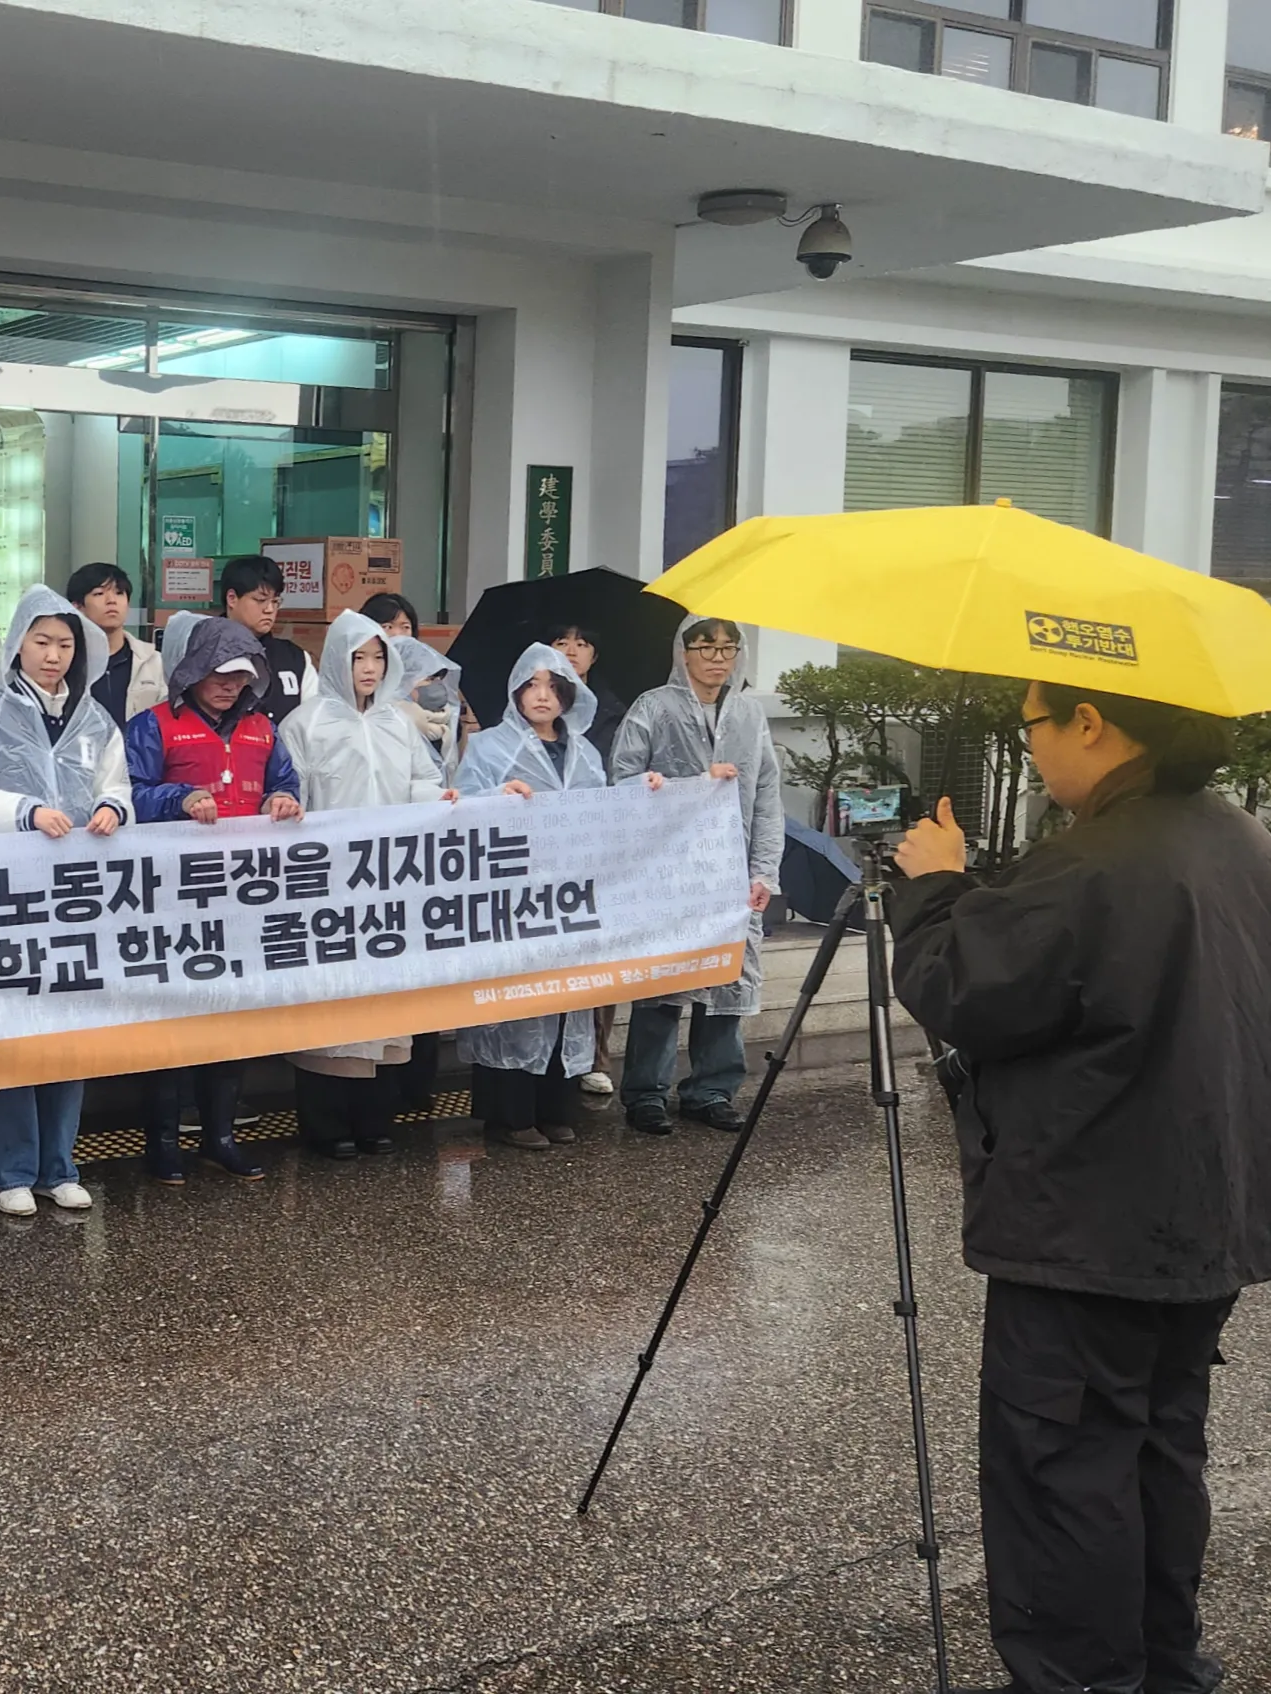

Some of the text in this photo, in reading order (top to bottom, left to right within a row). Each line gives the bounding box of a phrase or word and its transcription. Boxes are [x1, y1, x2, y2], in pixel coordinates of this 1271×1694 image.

[176, 536, 192, 546] AED
[299, 581, 319, 593] 30년
[1061, 619, 1131, 643] 핵오염수
[1066, 635, 1135, 657] 투기반대
[278, 671, 299, 695] D
[177, 842, 331, 909] 투쟁을
[347, 827, 529, 890] 지지하는
[118, 920, 242, 979] 학생,
[261, 901, 406, 970] 졸업생
[422, 880, 601, 951] 연대선언
